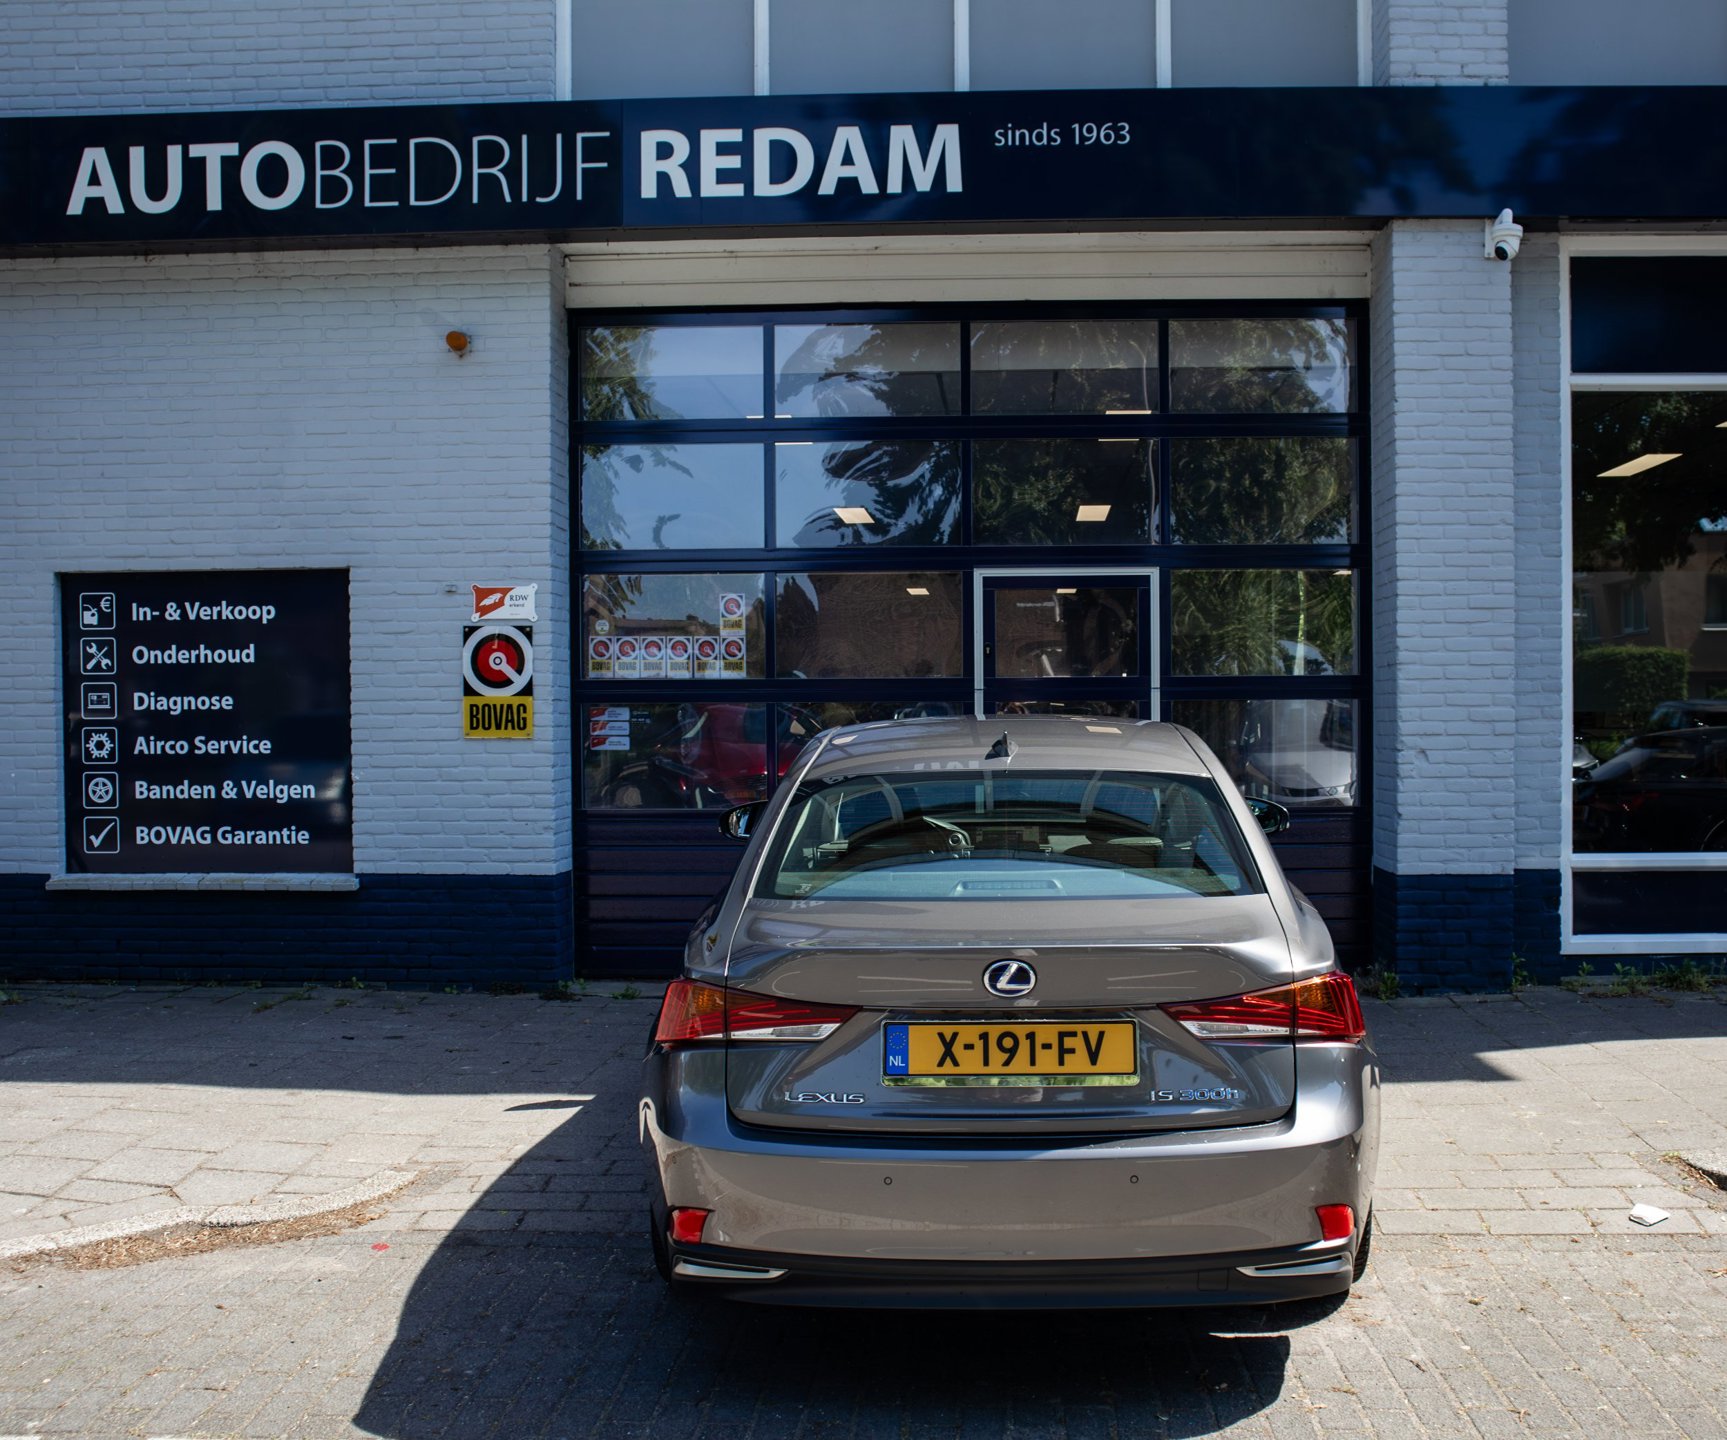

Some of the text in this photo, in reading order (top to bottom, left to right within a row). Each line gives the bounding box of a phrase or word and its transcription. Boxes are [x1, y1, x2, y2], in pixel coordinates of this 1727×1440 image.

[994, 122, 1131, 146] sinds 1963
[66, 123, 963, 215] AUTOBEDRIJF REDAM
[131, 600, 276, 624] In- & Verkoop
[131, 643, 255, 665] Onderhoud
[133, 691, 234, 716] Diagnose
[469, 703, 528, 731] BOVAG
[133, 734, 272, 755] Airco Service
[134, 778, 316, 804] Banden & Velgen
[135, 825, 310, 846] BOVAG Garantie
[889, 1055, 906, 1067] NL
[936, 1030, 1106, 1068] X-191-FV
[784, 1091, 865, 1104] LEXUS
[1150, 1087, 1239, 1101] IS 300h
